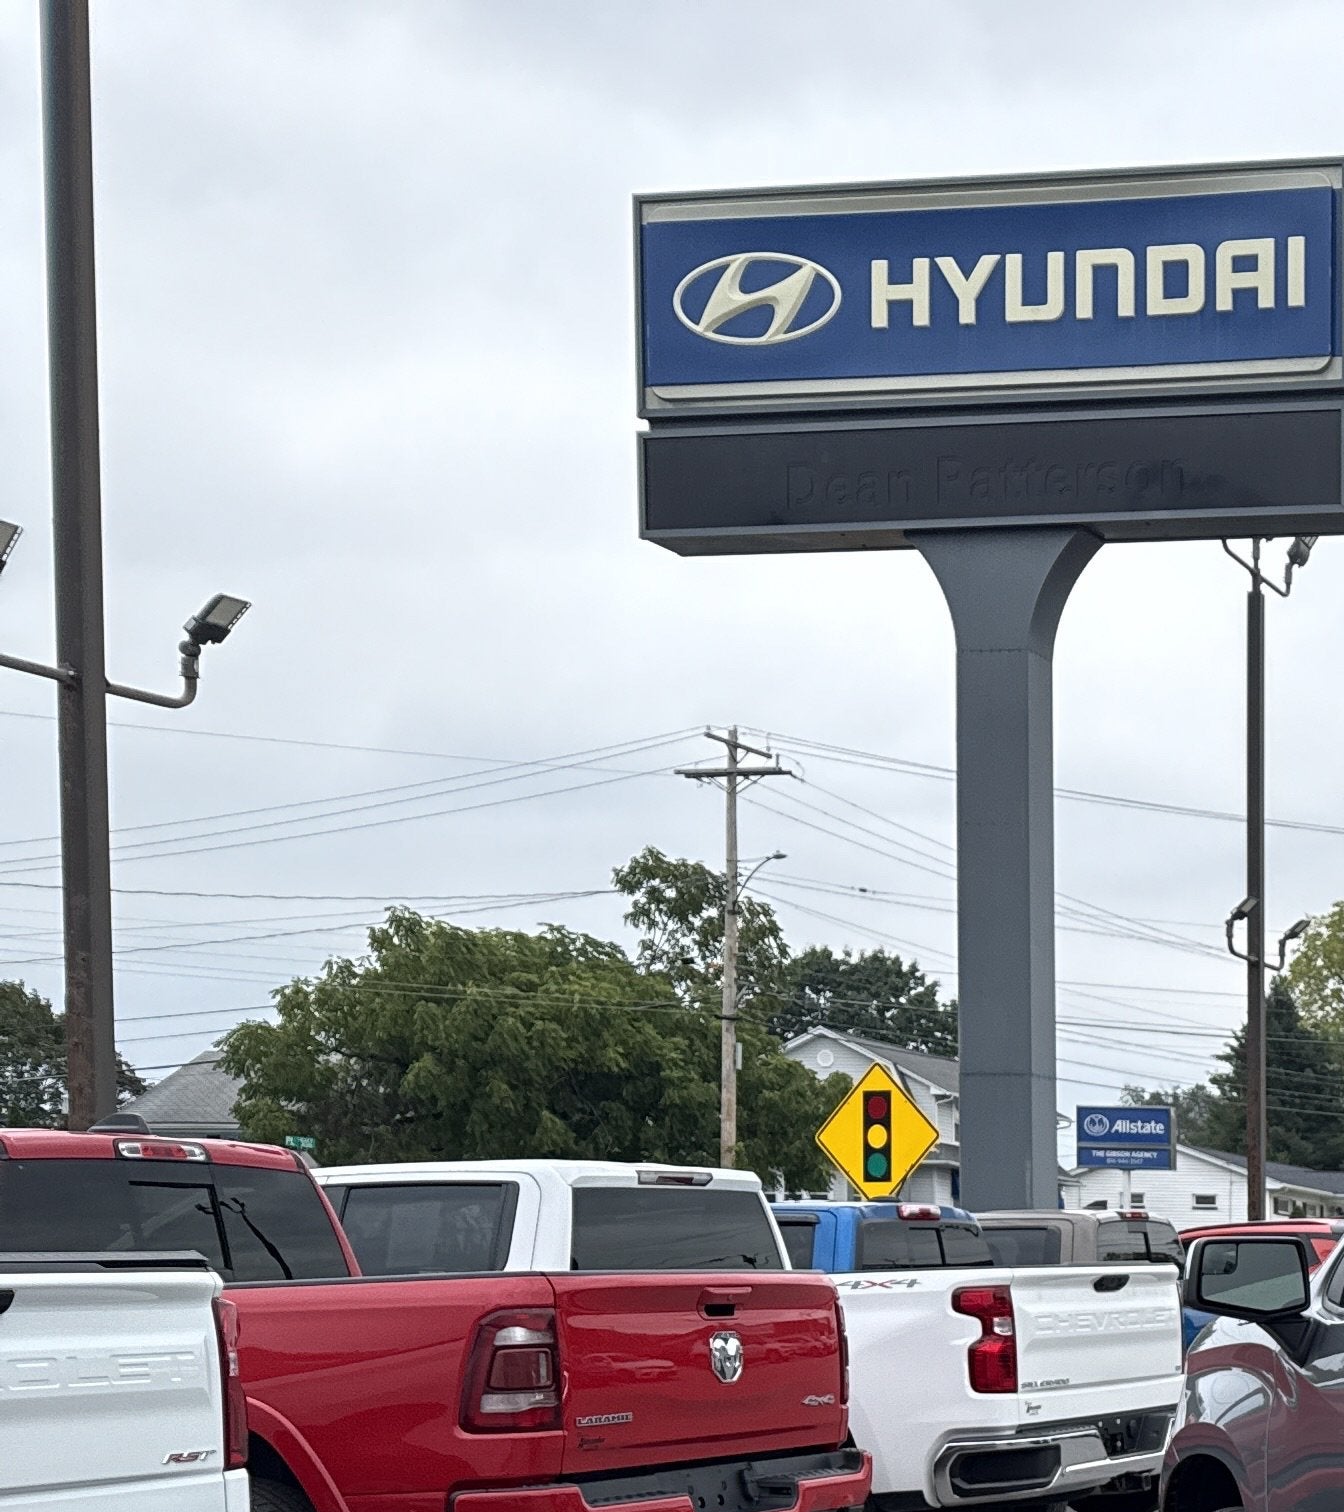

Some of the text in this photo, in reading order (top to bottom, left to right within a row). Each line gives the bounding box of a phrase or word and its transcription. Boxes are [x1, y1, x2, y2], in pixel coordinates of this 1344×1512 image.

[871, 235, 1306, 328] HYUNDAI
[784, 451, 1187, 509] Dean Patterson
[1111, 1120, 1165, 1134] Allstate
[0, 1350, 197, 1391] OLET
[576, 1412, 633, 1427] LARAMIE
[160, 1449, 216, 1465] RST
